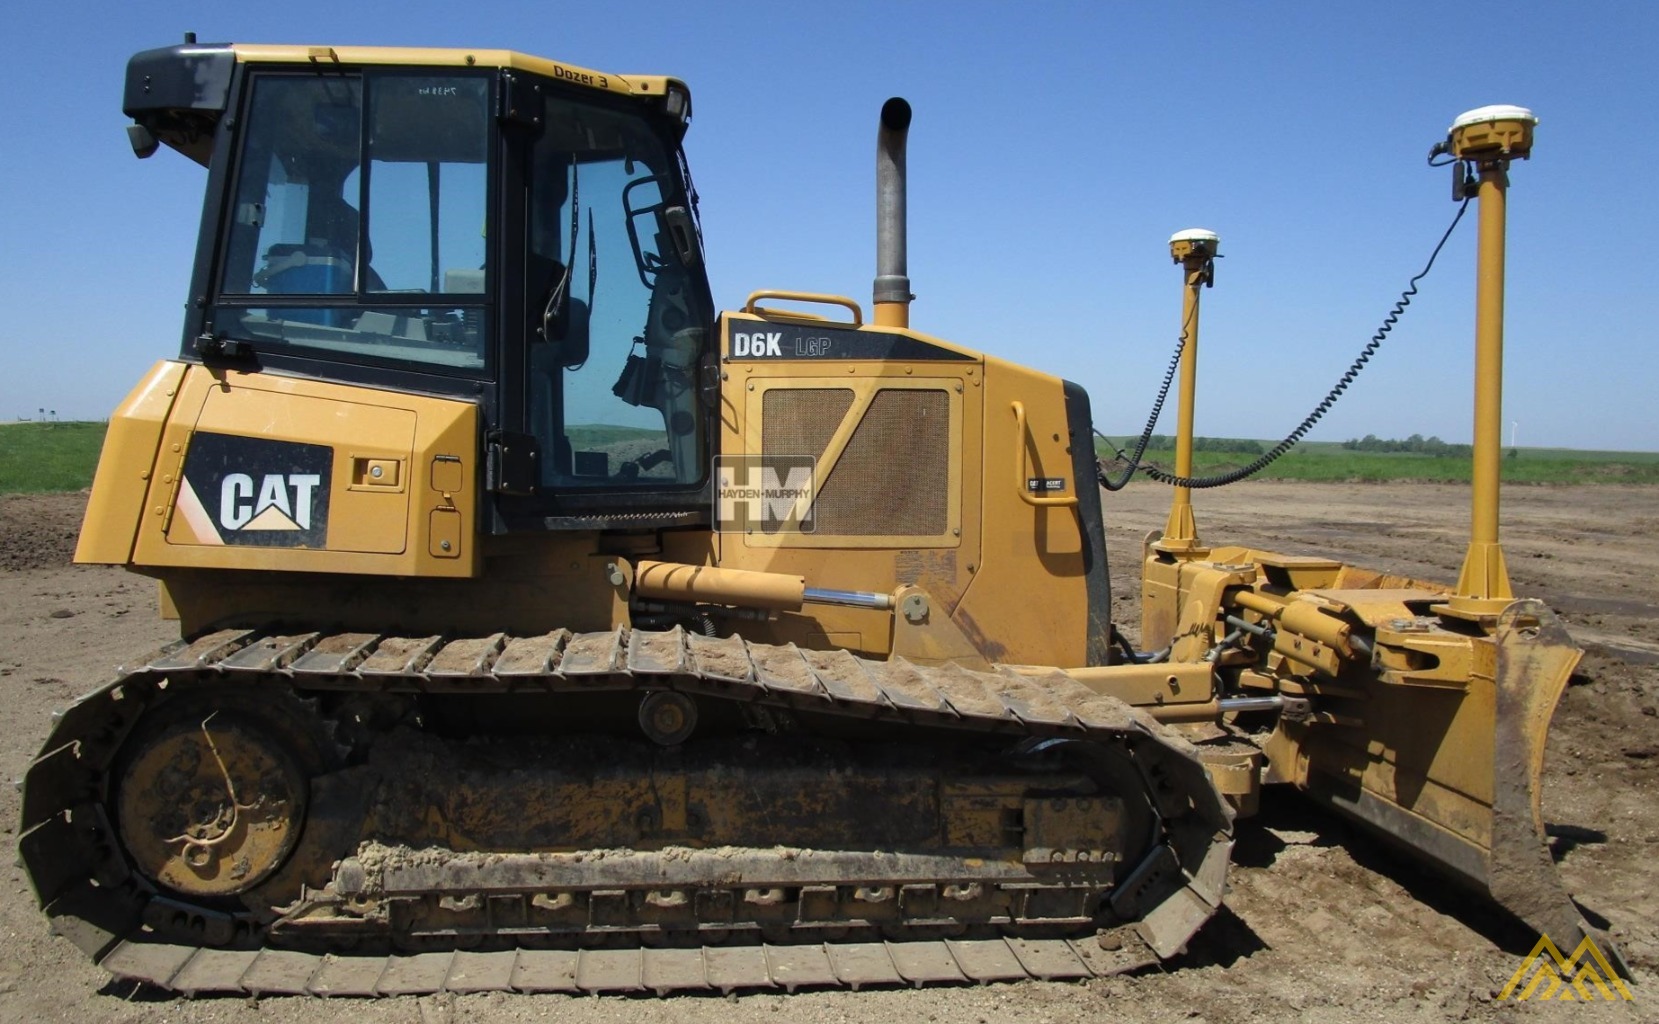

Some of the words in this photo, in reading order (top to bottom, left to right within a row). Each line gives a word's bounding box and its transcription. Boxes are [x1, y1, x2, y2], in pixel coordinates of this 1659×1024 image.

[553, 65, 594, 85] Dozer
[598, 75, 608, 88] 3
[734, 332, 783, 357] D6K
[795, 337, 832, 357] LGP
[220, 473, 320, 530] CAT
